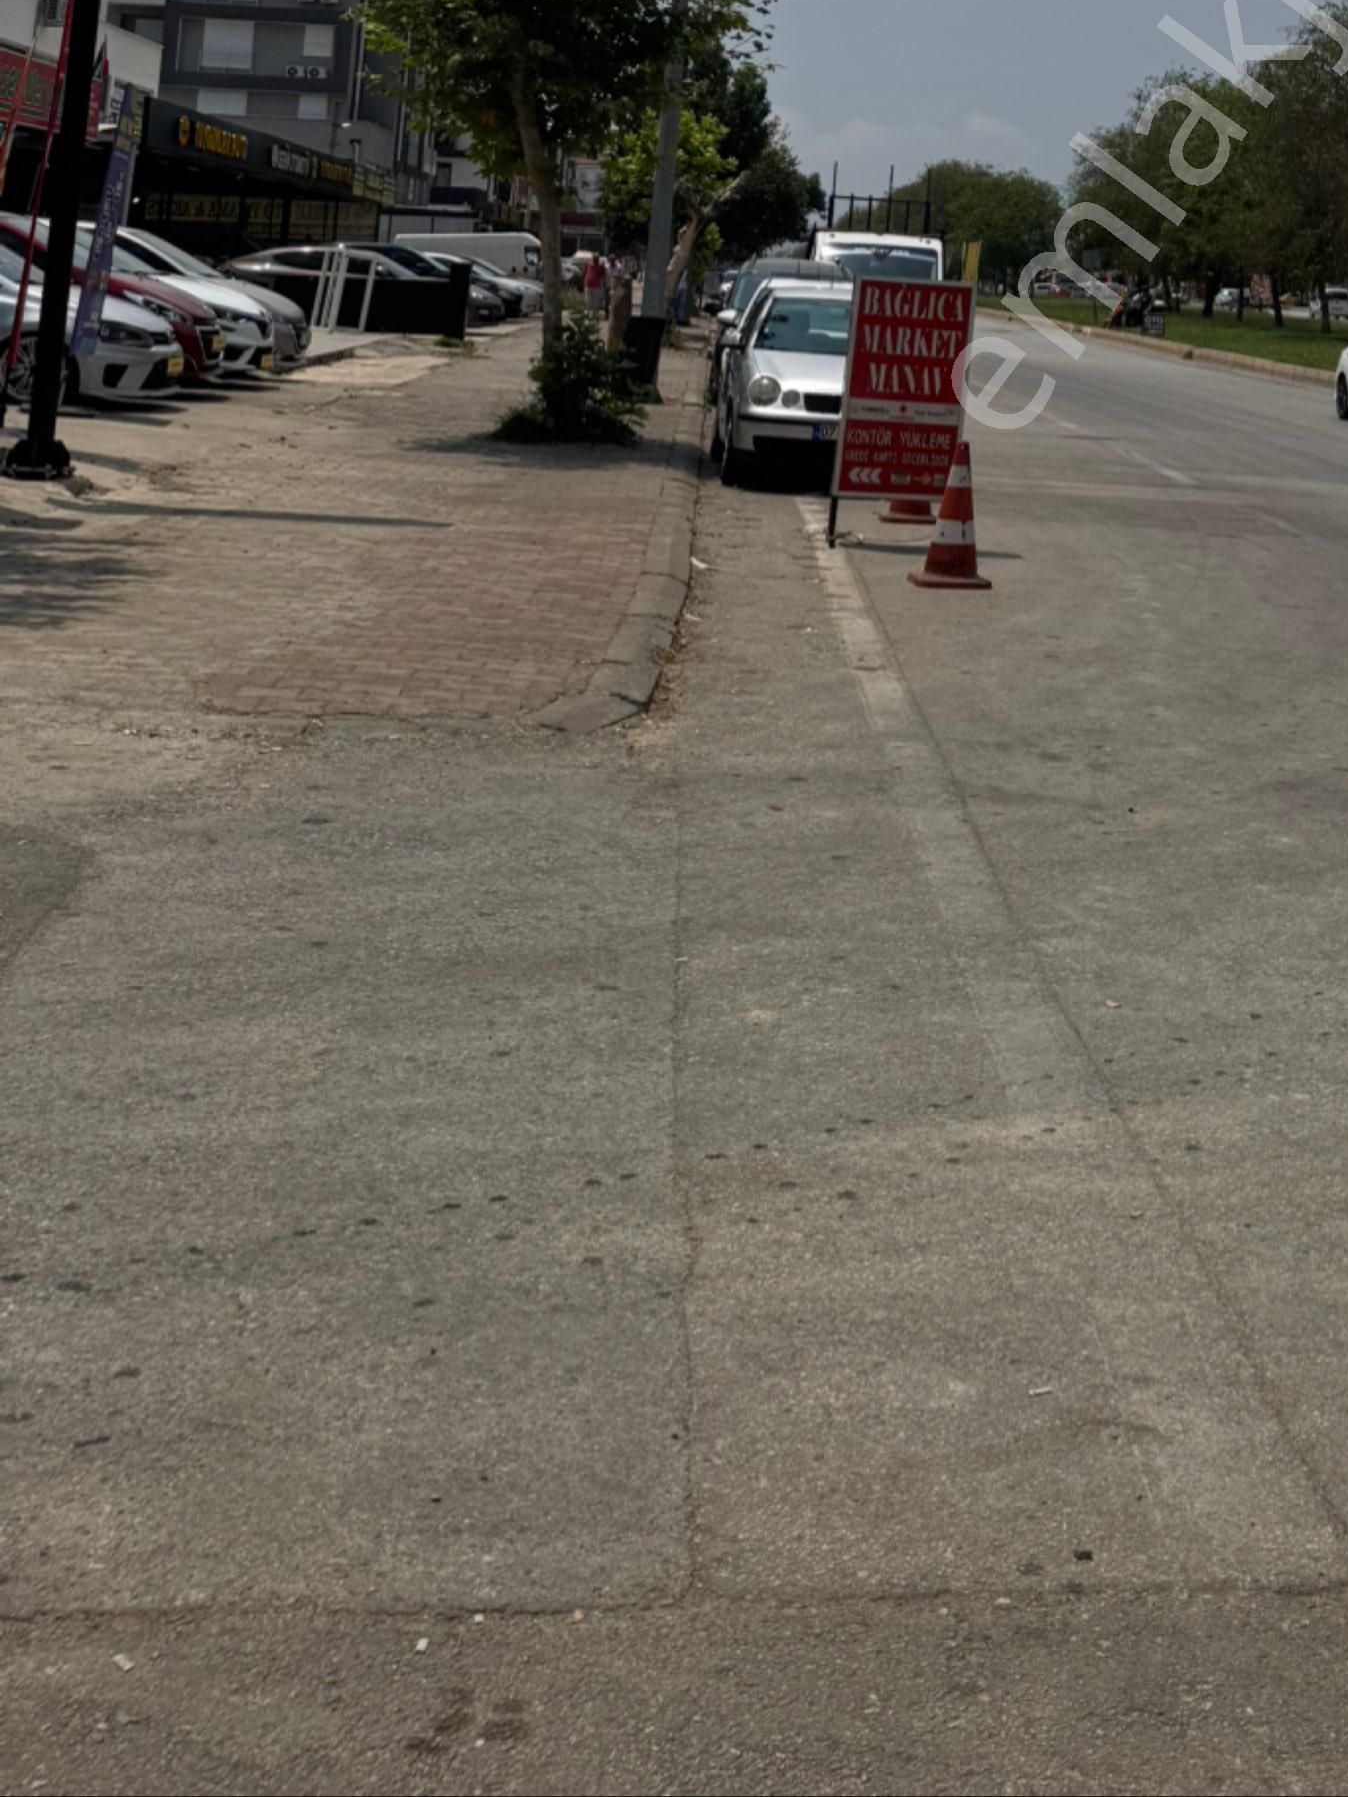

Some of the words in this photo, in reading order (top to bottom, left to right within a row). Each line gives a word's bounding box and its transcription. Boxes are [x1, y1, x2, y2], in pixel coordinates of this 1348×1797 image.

[863, 284, 965, 321] BAĞLICA
[860, 323, 962, 359] MARKET
[866, 361, 947, 396] MANAV
[846, 424, 893, 447] KONTÖR
[899, 427, 952, 450] YÜKLEME
